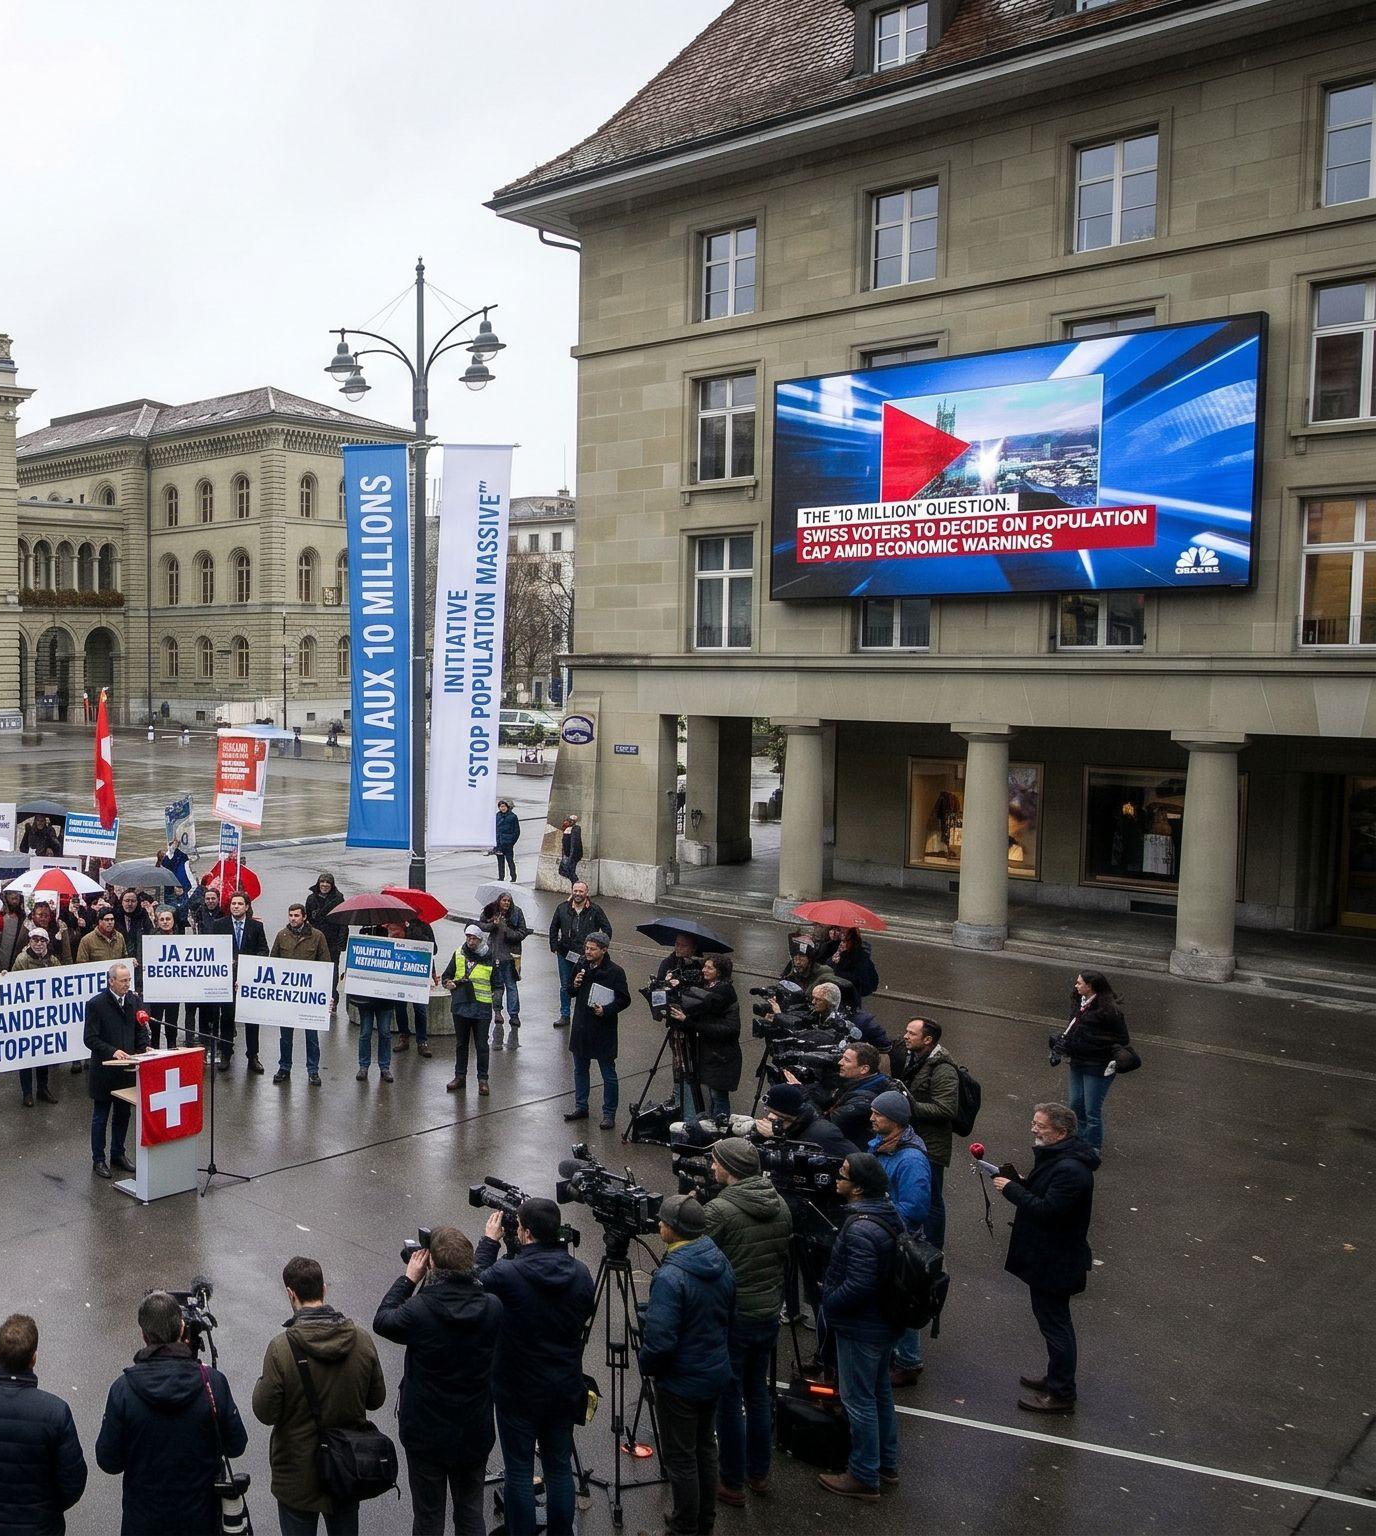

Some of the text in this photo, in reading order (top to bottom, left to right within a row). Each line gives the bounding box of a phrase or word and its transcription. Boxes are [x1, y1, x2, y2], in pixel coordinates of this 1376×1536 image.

[803, 510, 831, 524] THE
[926, 498, 1010, 518] QUESTION:
[802, 508, 1148, 544] SWISS VOTERS TO DECIDE ON POPULATION
[802, 533, 1053, 560] CAP AMID ECONOMIC WARNINGS
[359, 475, 396, 801] NON AUX 10 MILLIONS
[444, 590, 468, 693] INITIATIVE
[471, 593, 496, 718] POPULATION
[158, 944, 215, 962] JA ZUM
[147, 964, 229, 978] BEGRENZUNG
[253, 966, 313, 988] JA ZUM
[51, 971, 109, 999] RETTE
[241, 985, 327, 1006] BEGRENZUNG
